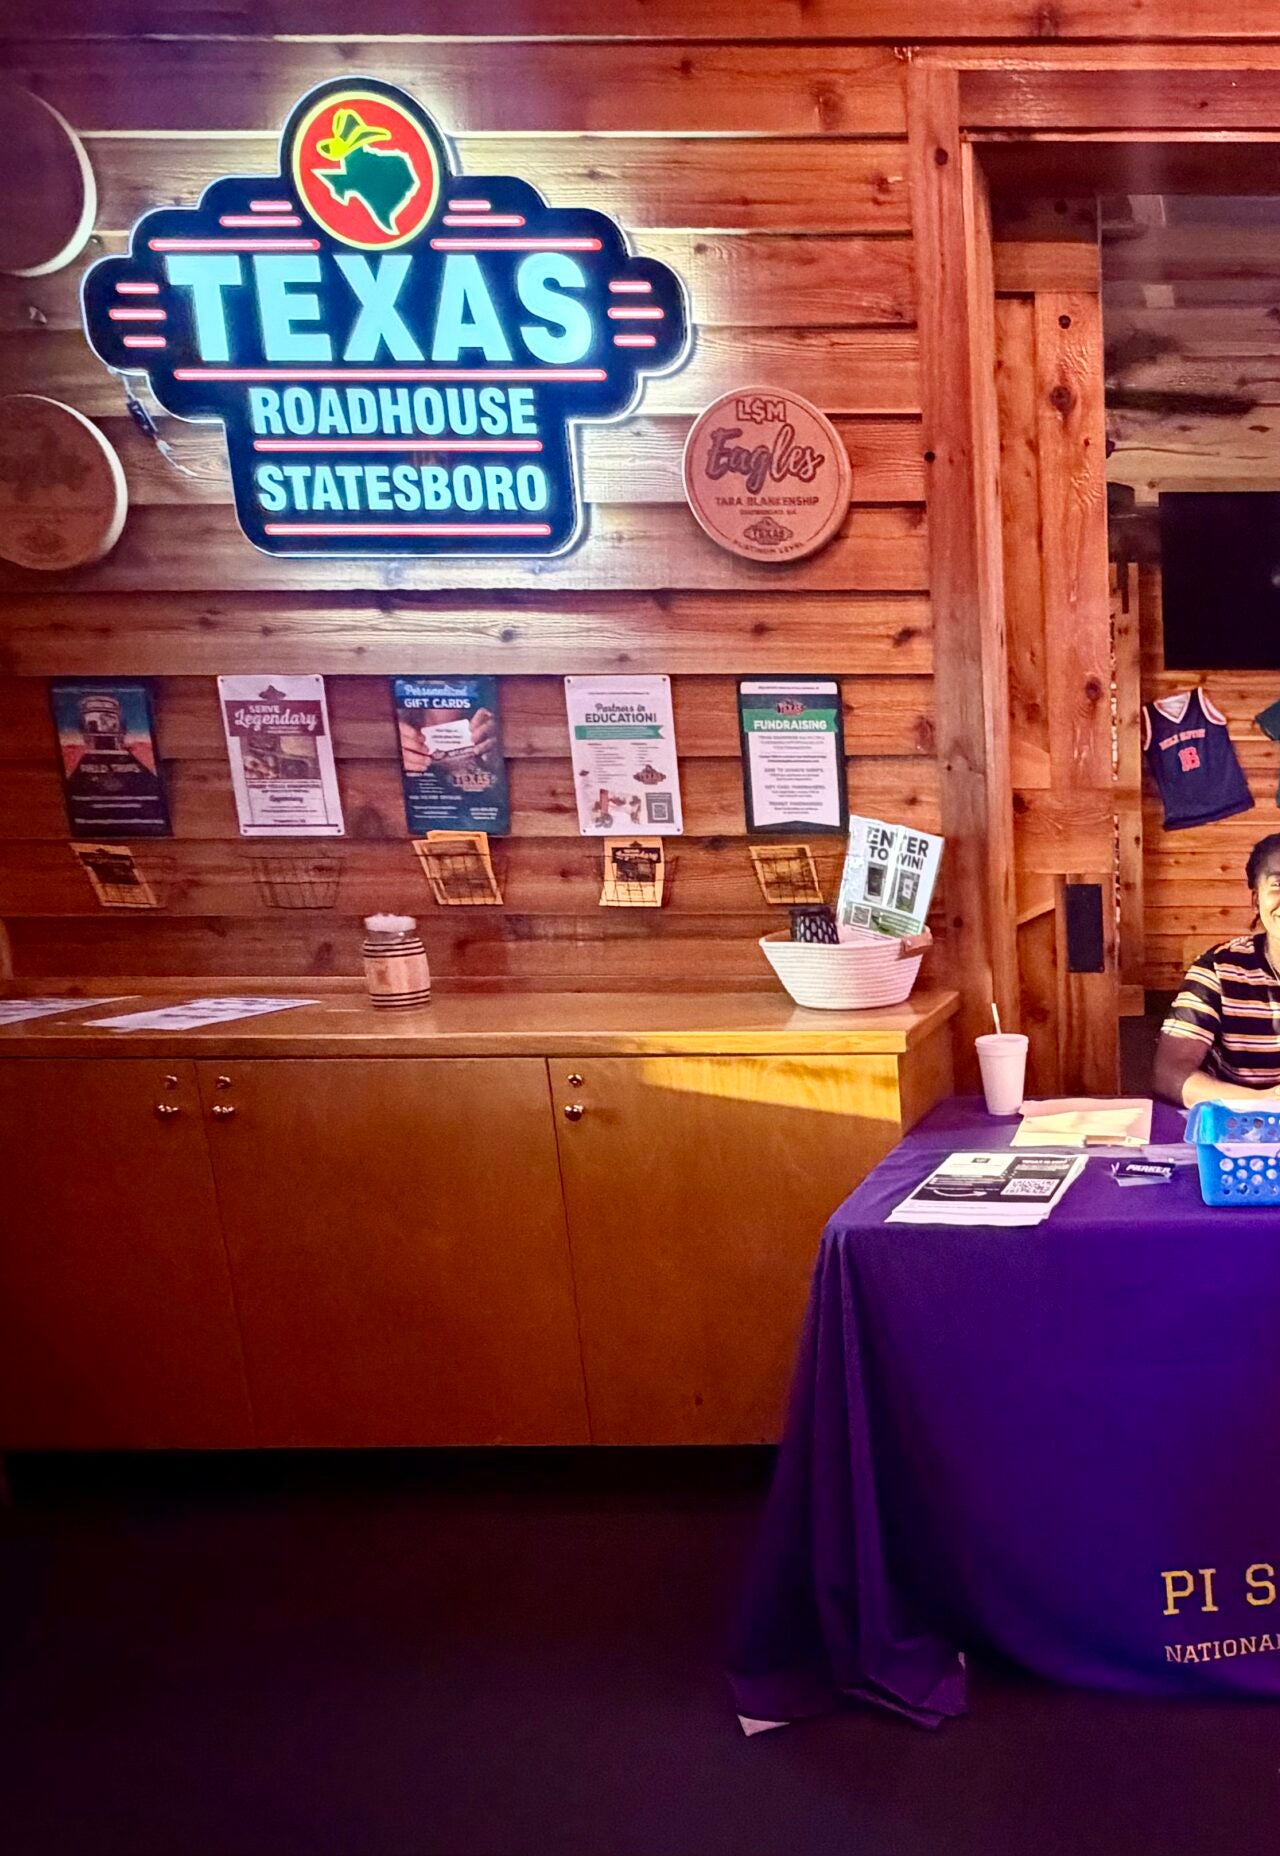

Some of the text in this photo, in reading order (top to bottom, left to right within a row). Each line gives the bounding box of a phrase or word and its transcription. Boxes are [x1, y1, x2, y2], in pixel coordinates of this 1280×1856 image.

[165, 253, 593, 364] TEXAS
[249, 387, 538, 437] ROADHOUSE
[705, 423, 825, 494] Eagles
[257, 464, 548, 513] STATESBORO
[715, 496, 820, 506] TARA BLANKENSHIP
[250, 705, 281, 714] SERVE
[404, 698, 471, 709] GIFT CARDS
[234, 709, 318, 732] Legendary
[585, 713, 657, 723] EDUCATION!
[753, 720, 828, 730] FUNDRAISING
[869, 846, 889, 860] TO
[1126, 1163, 1172, 1174] PARKER
[1160, 1568, 1219, 1616] PI
